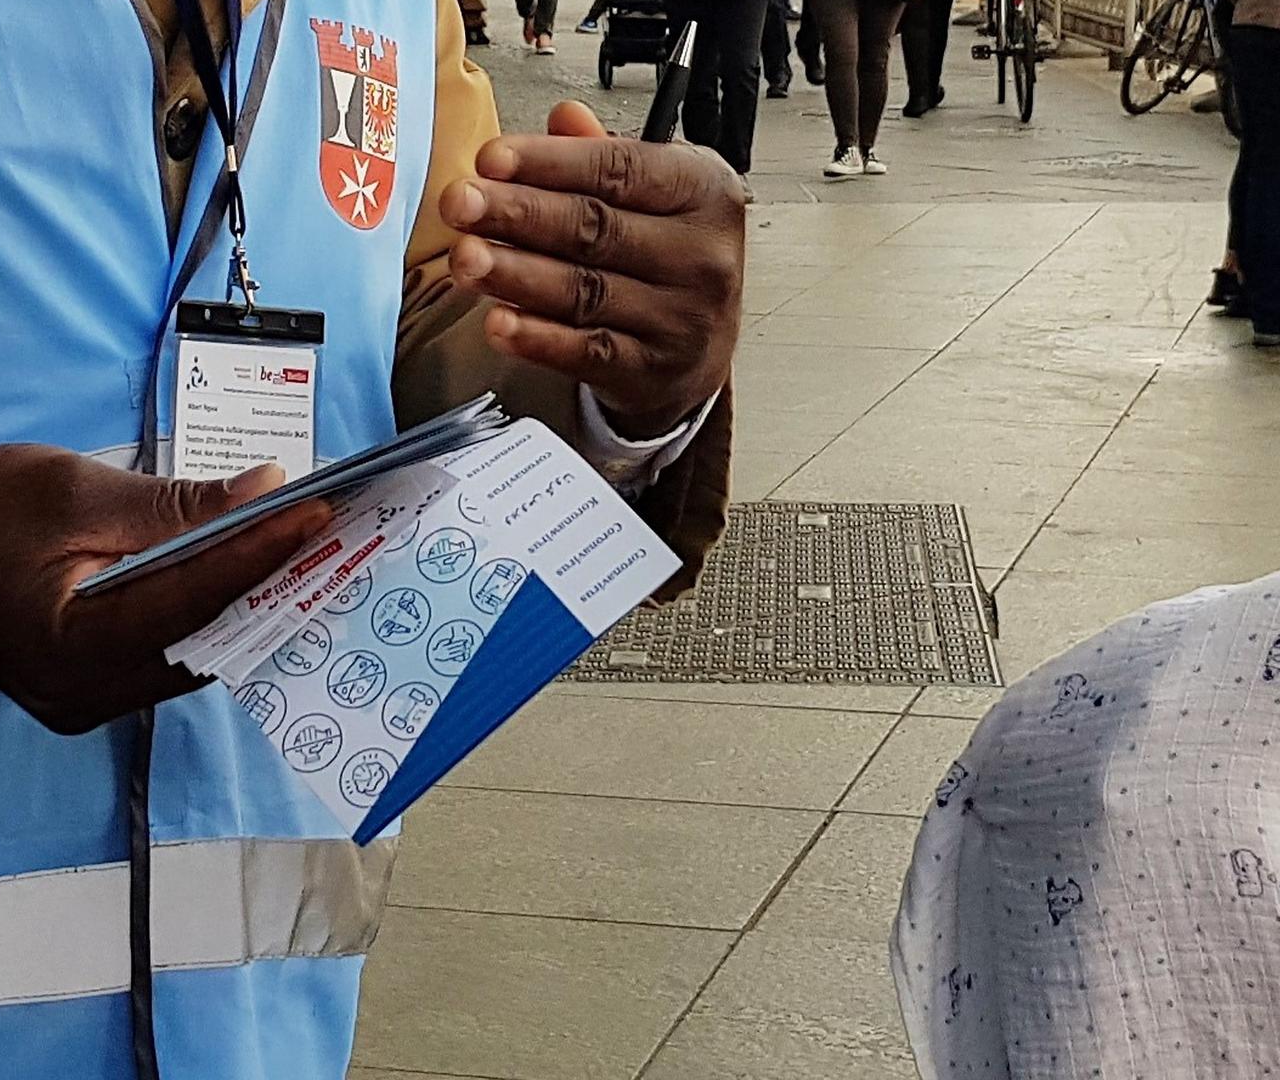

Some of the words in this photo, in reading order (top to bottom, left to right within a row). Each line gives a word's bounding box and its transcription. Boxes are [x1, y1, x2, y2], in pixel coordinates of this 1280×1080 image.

[527, 496, 600, 555] Koronawirus
[556, 521, 624, 577] Coronavirus
[580, 547, 648, 604] Coronavirus
